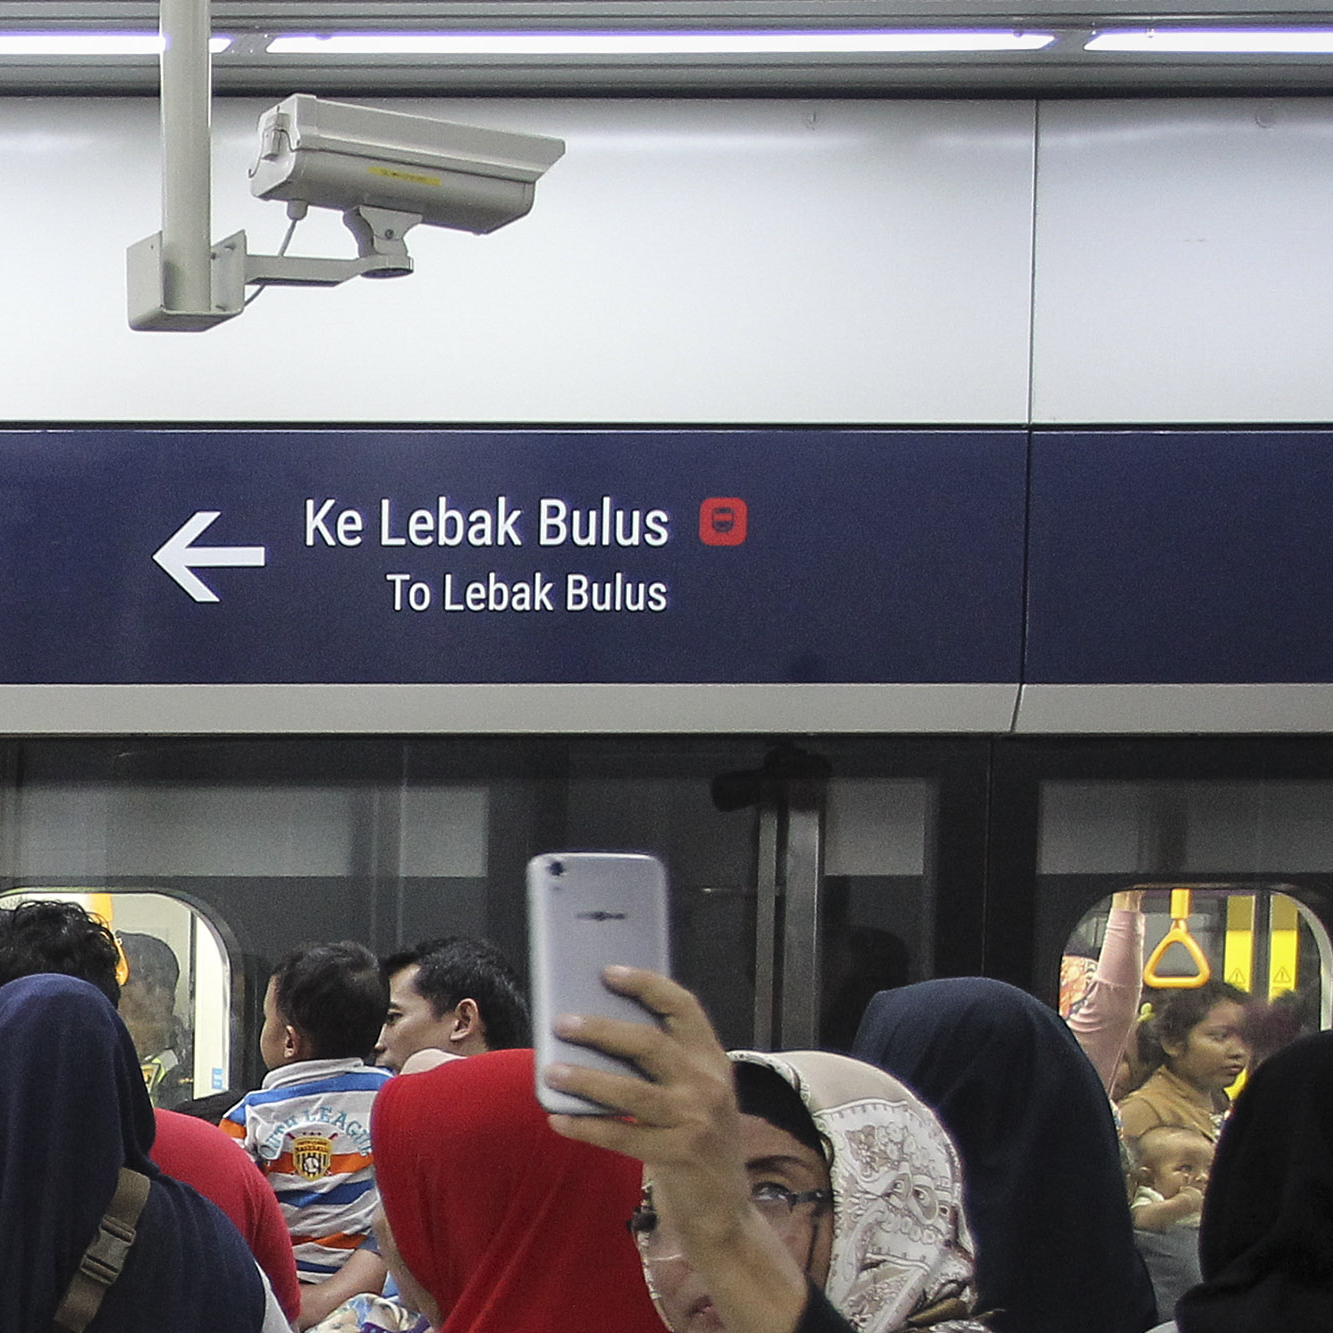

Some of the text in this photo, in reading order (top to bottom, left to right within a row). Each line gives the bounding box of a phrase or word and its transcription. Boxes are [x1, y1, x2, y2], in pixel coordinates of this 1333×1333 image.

[304, 496, 668, 546] Ke Lebak Bulus
[386, 574, 667, 611] To Lebak Bulus
